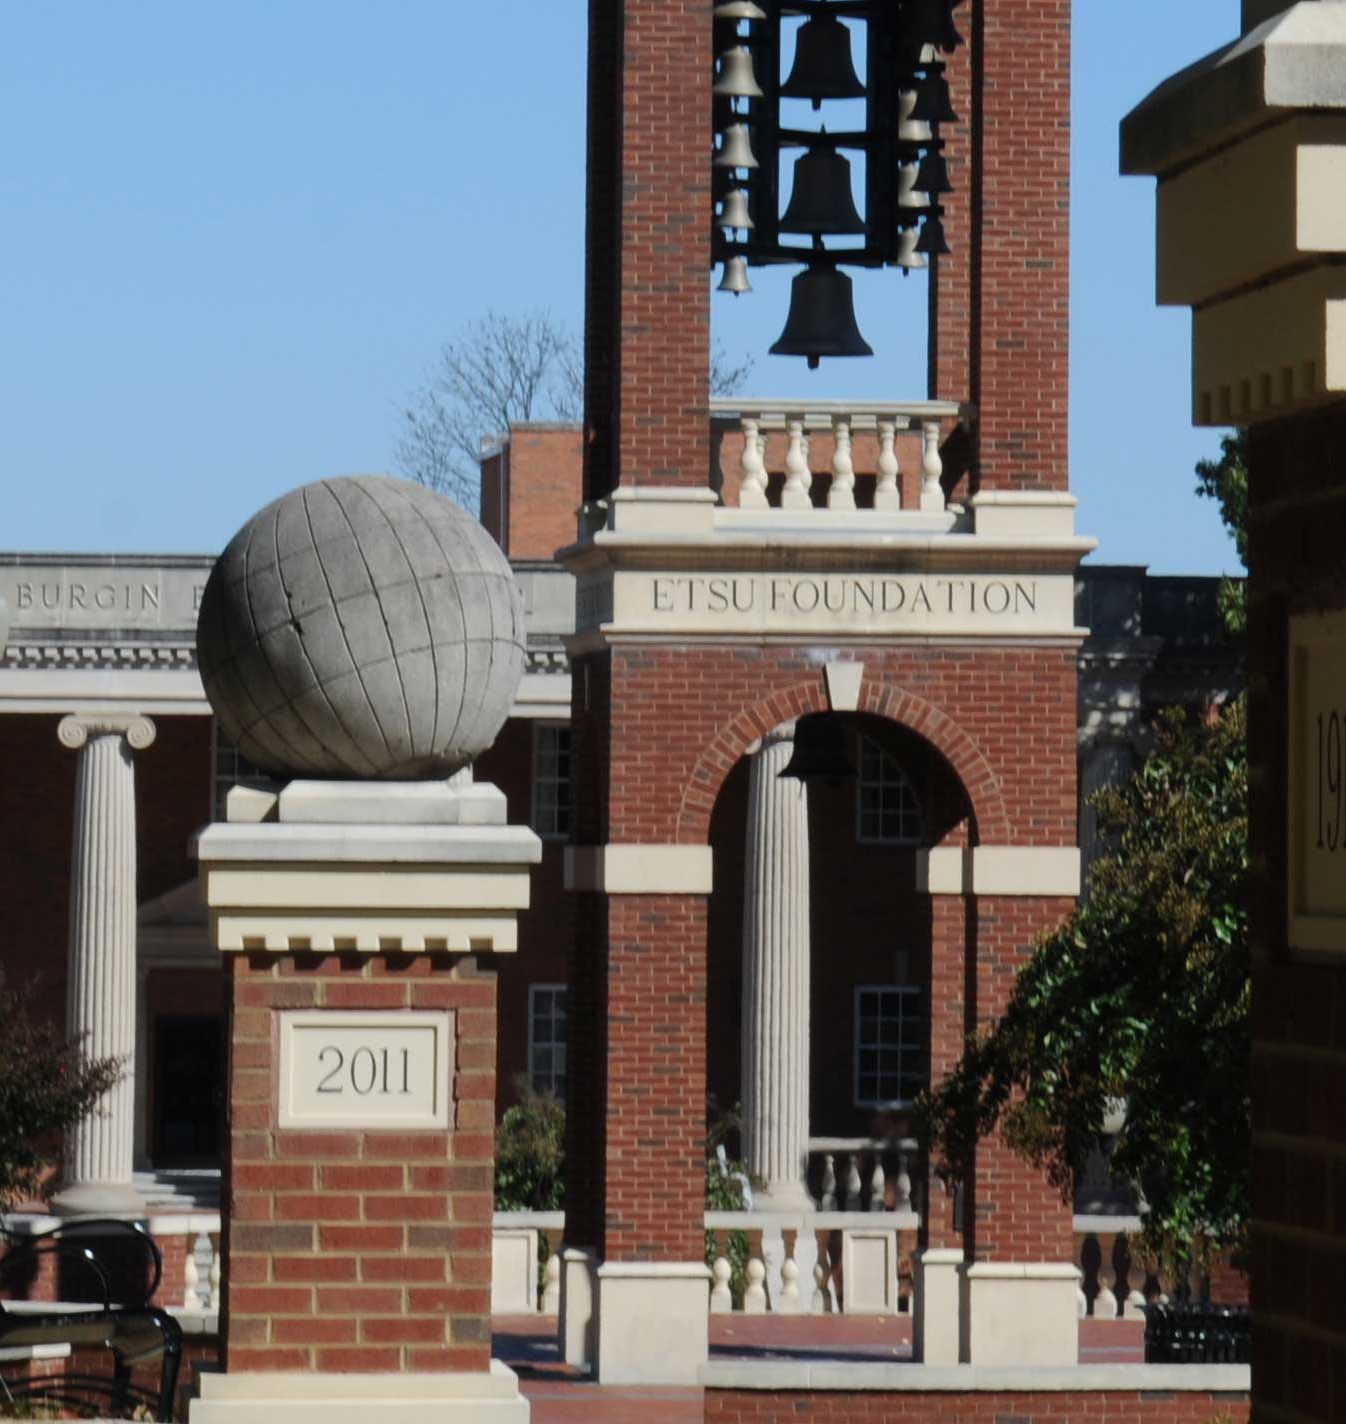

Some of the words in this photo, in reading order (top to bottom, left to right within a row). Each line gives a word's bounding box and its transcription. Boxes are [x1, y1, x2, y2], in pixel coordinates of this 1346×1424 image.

[16, 583, 160, 610] BURGIN
[652, 578, 756, 613] ETSU
[770, 579, 1038, 615] FOUNDATION
[315, 1045, 413, 1096] 2011
